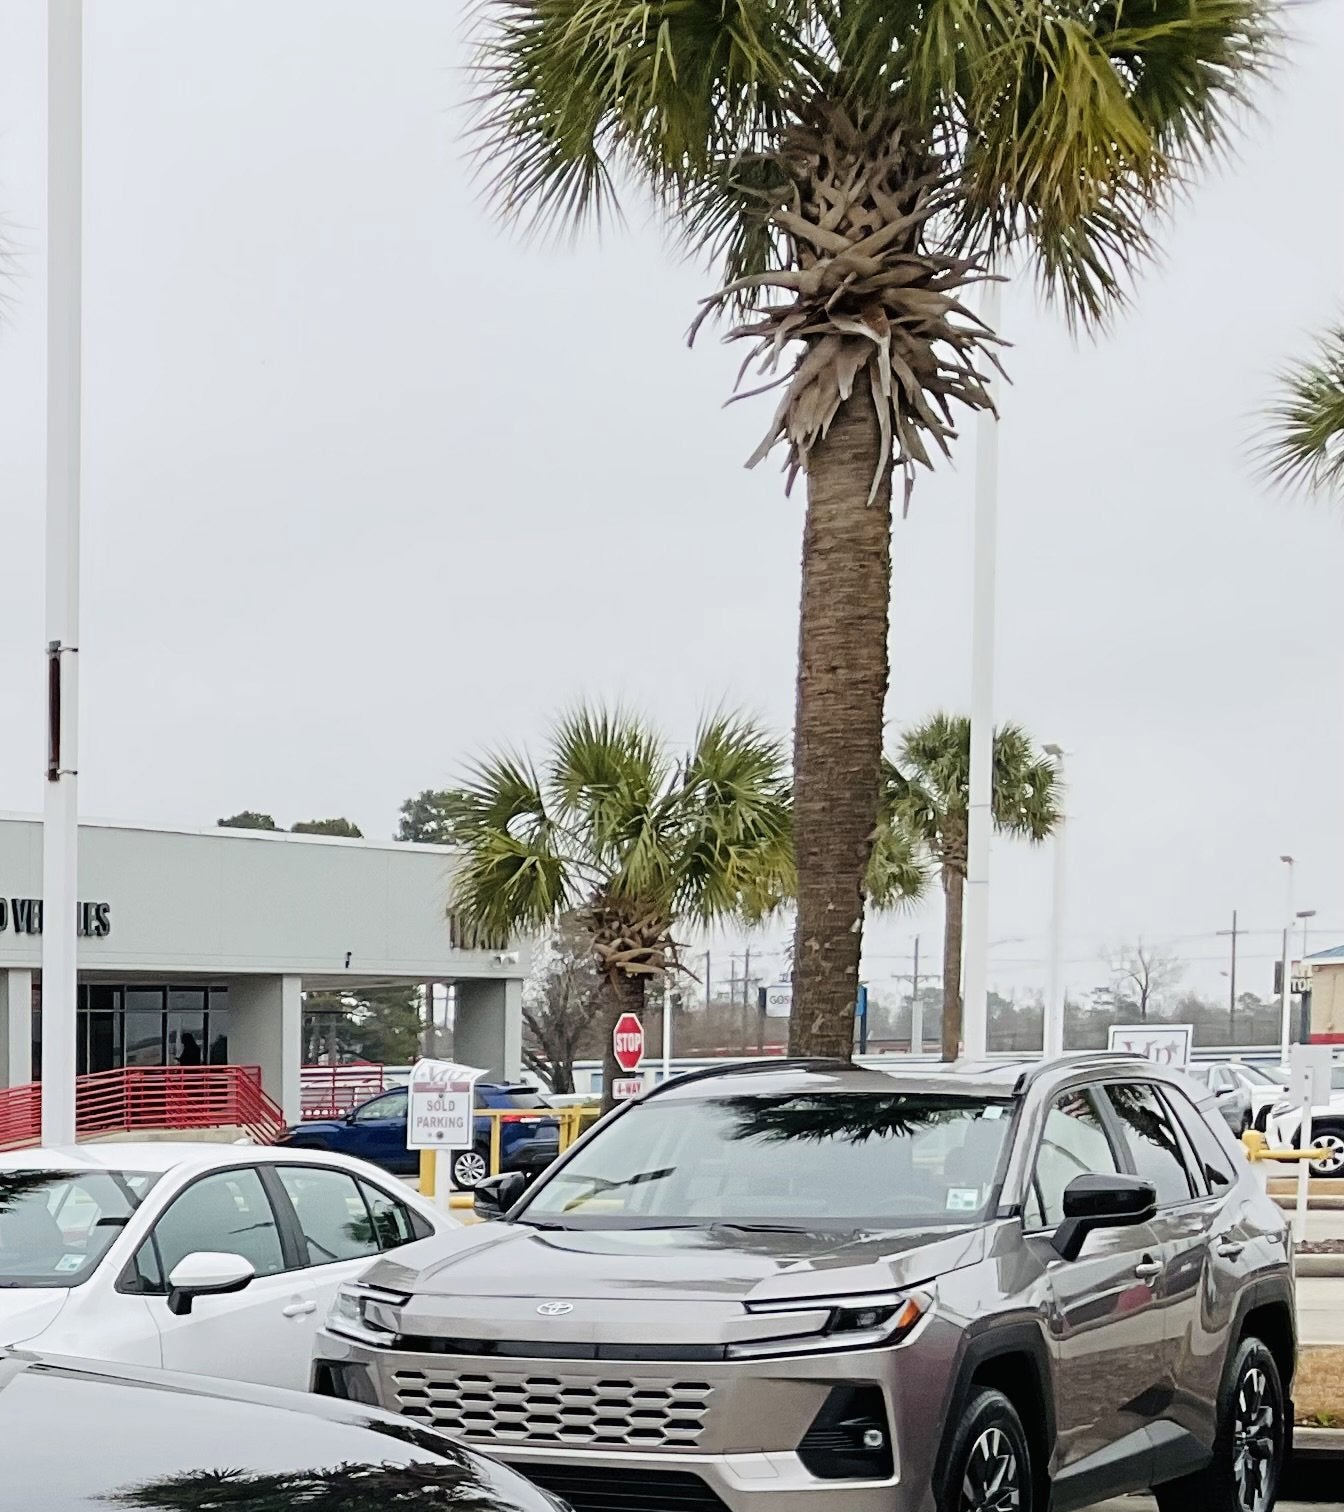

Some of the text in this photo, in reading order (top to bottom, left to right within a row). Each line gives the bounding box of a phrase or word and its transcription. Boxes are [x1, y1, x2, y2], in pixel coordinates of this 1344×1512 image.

[10, 898, 111, 937] VELES
[616, 1032, 641, 1053] STOP
[616, 1082, 641, 1095] 4-WAY
[426, 1100, 456, 1112] SOLD
[416, 1116, 464, 1129] PARKING
